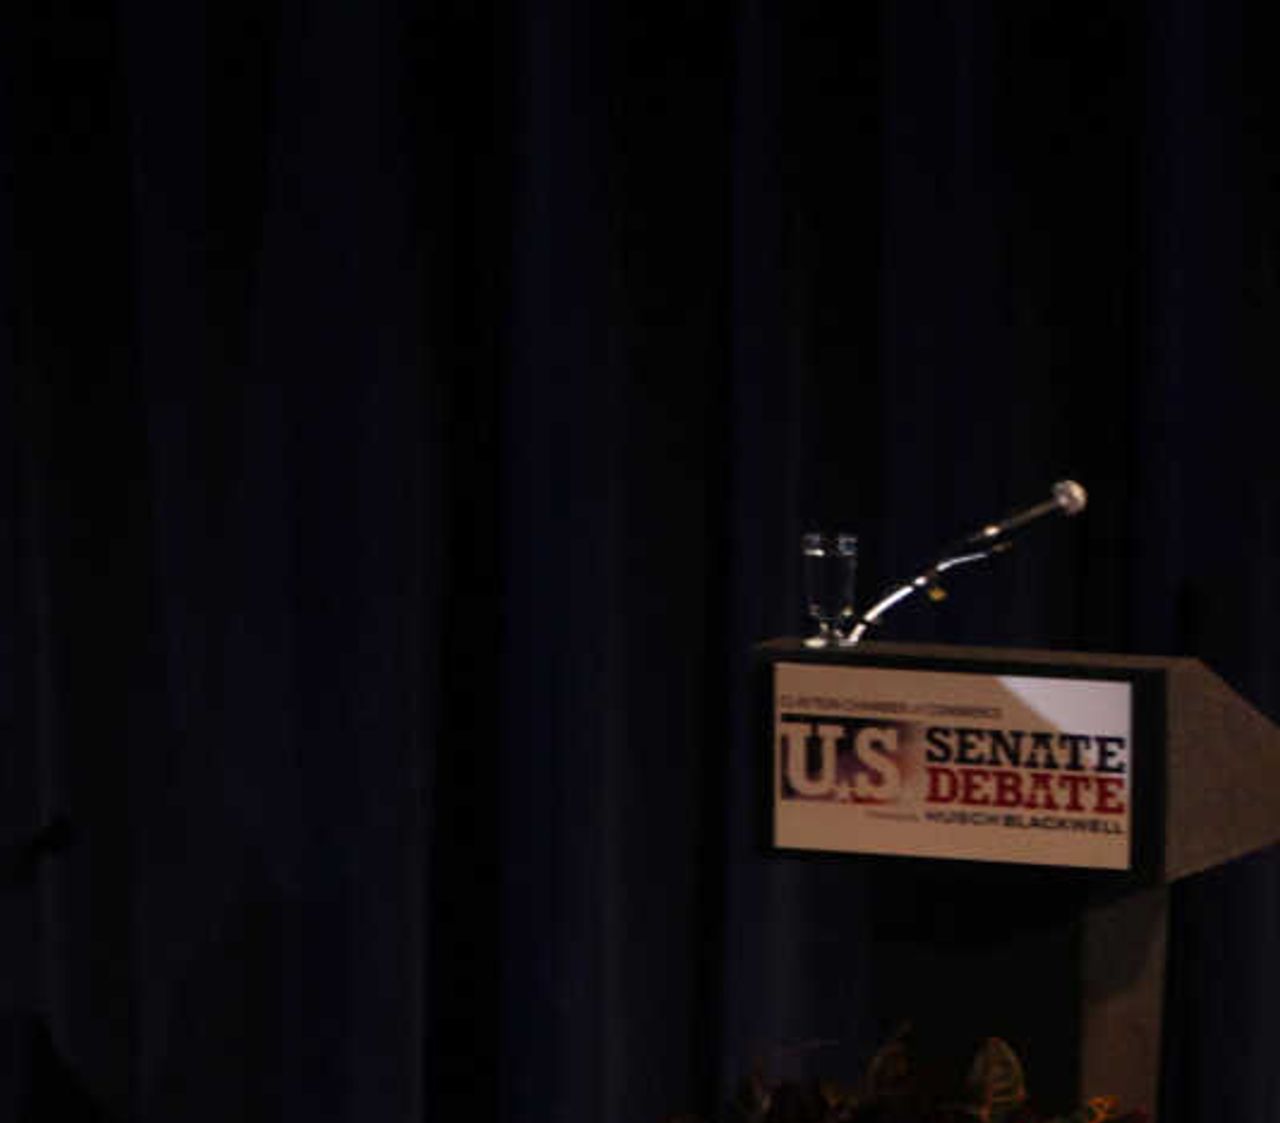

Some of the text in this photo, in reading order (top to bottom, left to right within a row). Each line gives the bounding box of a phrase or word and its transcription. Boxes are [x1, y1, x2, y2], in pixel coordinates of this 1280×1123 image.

[926, 727, 1126, 773] SENATE
[926, 767, 1125, 815] DEBATE
[1003, 815, 1125, 834] BLACKWELL
